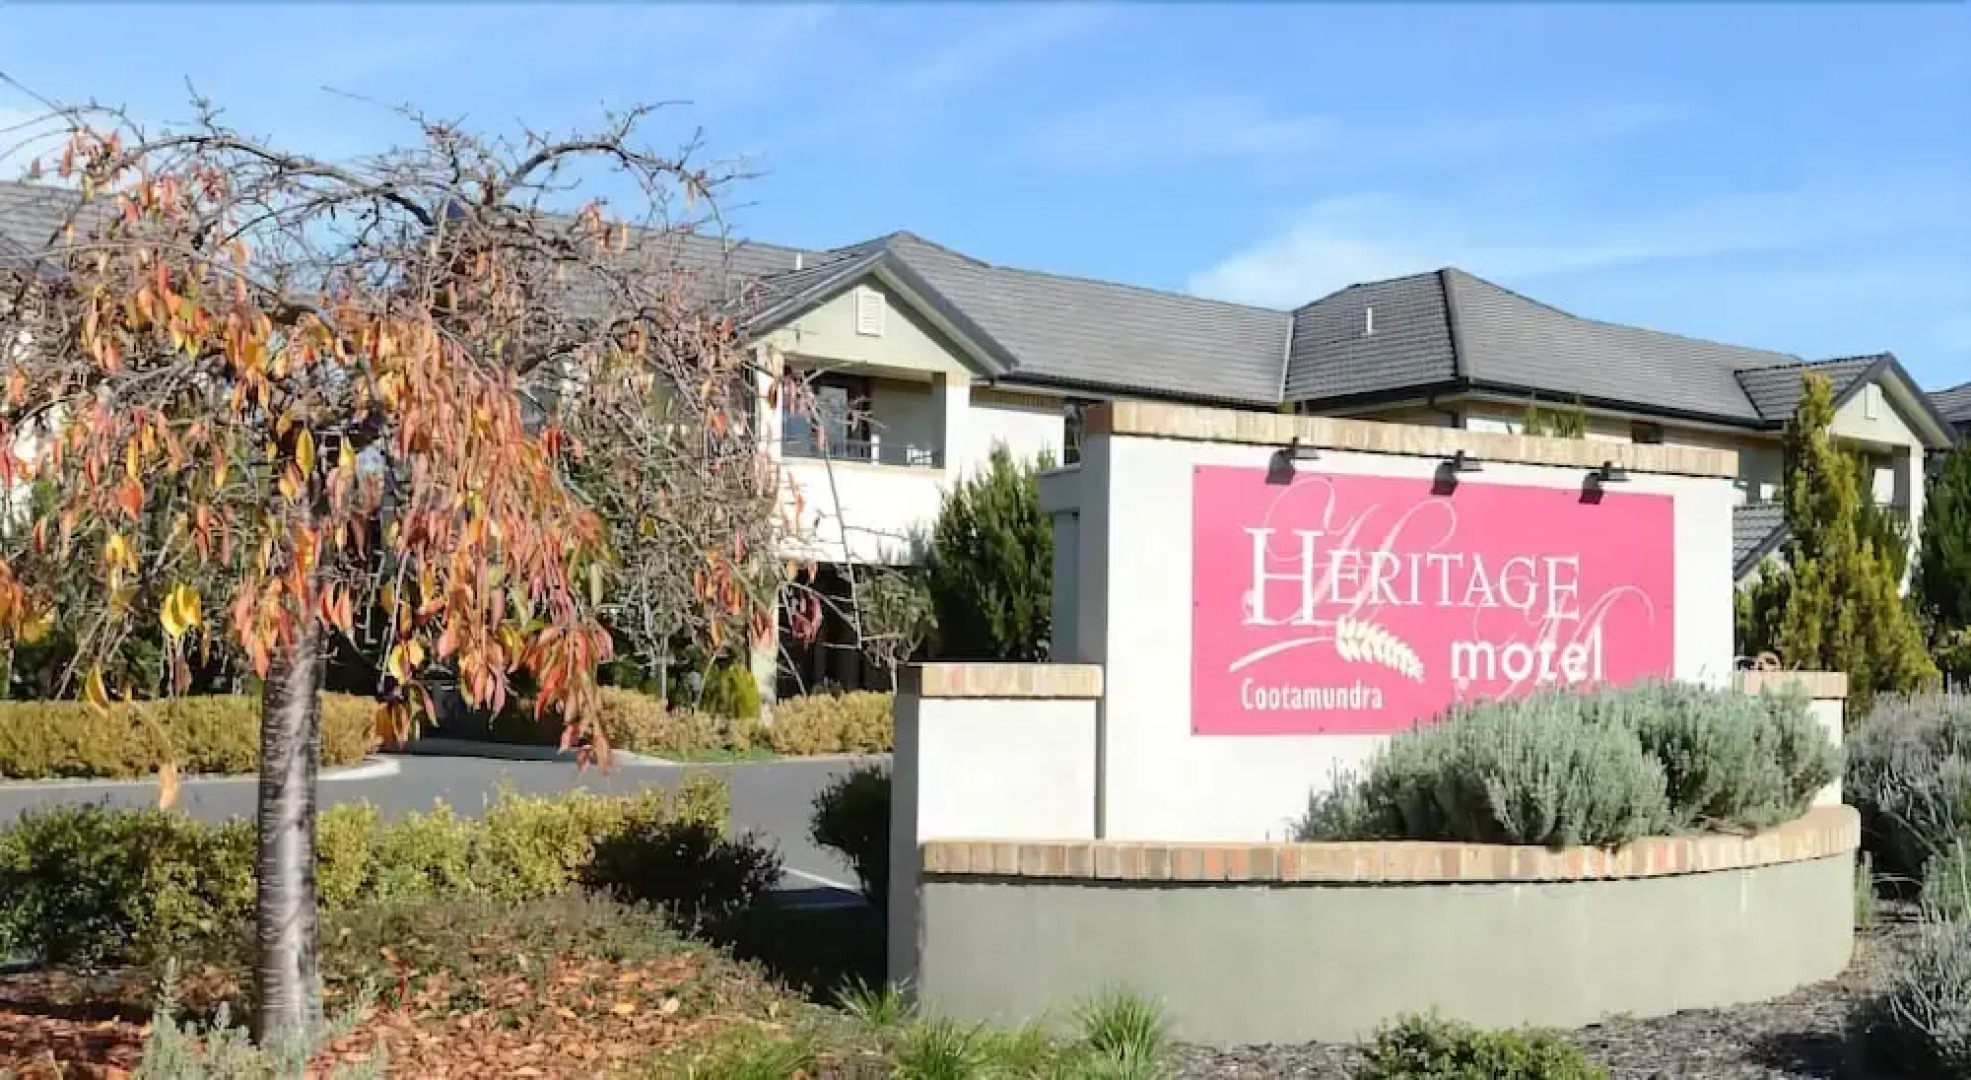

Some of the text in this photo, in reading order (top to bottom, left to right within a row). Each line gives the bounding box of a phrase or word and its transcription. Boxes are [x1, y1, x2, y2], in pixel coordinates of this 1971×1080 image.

[1243, 526, 1580, 626] HERITAGE
[1451, 622, 1603, 682] motel
[1241, 678, 1383, 711] Cootamundra
